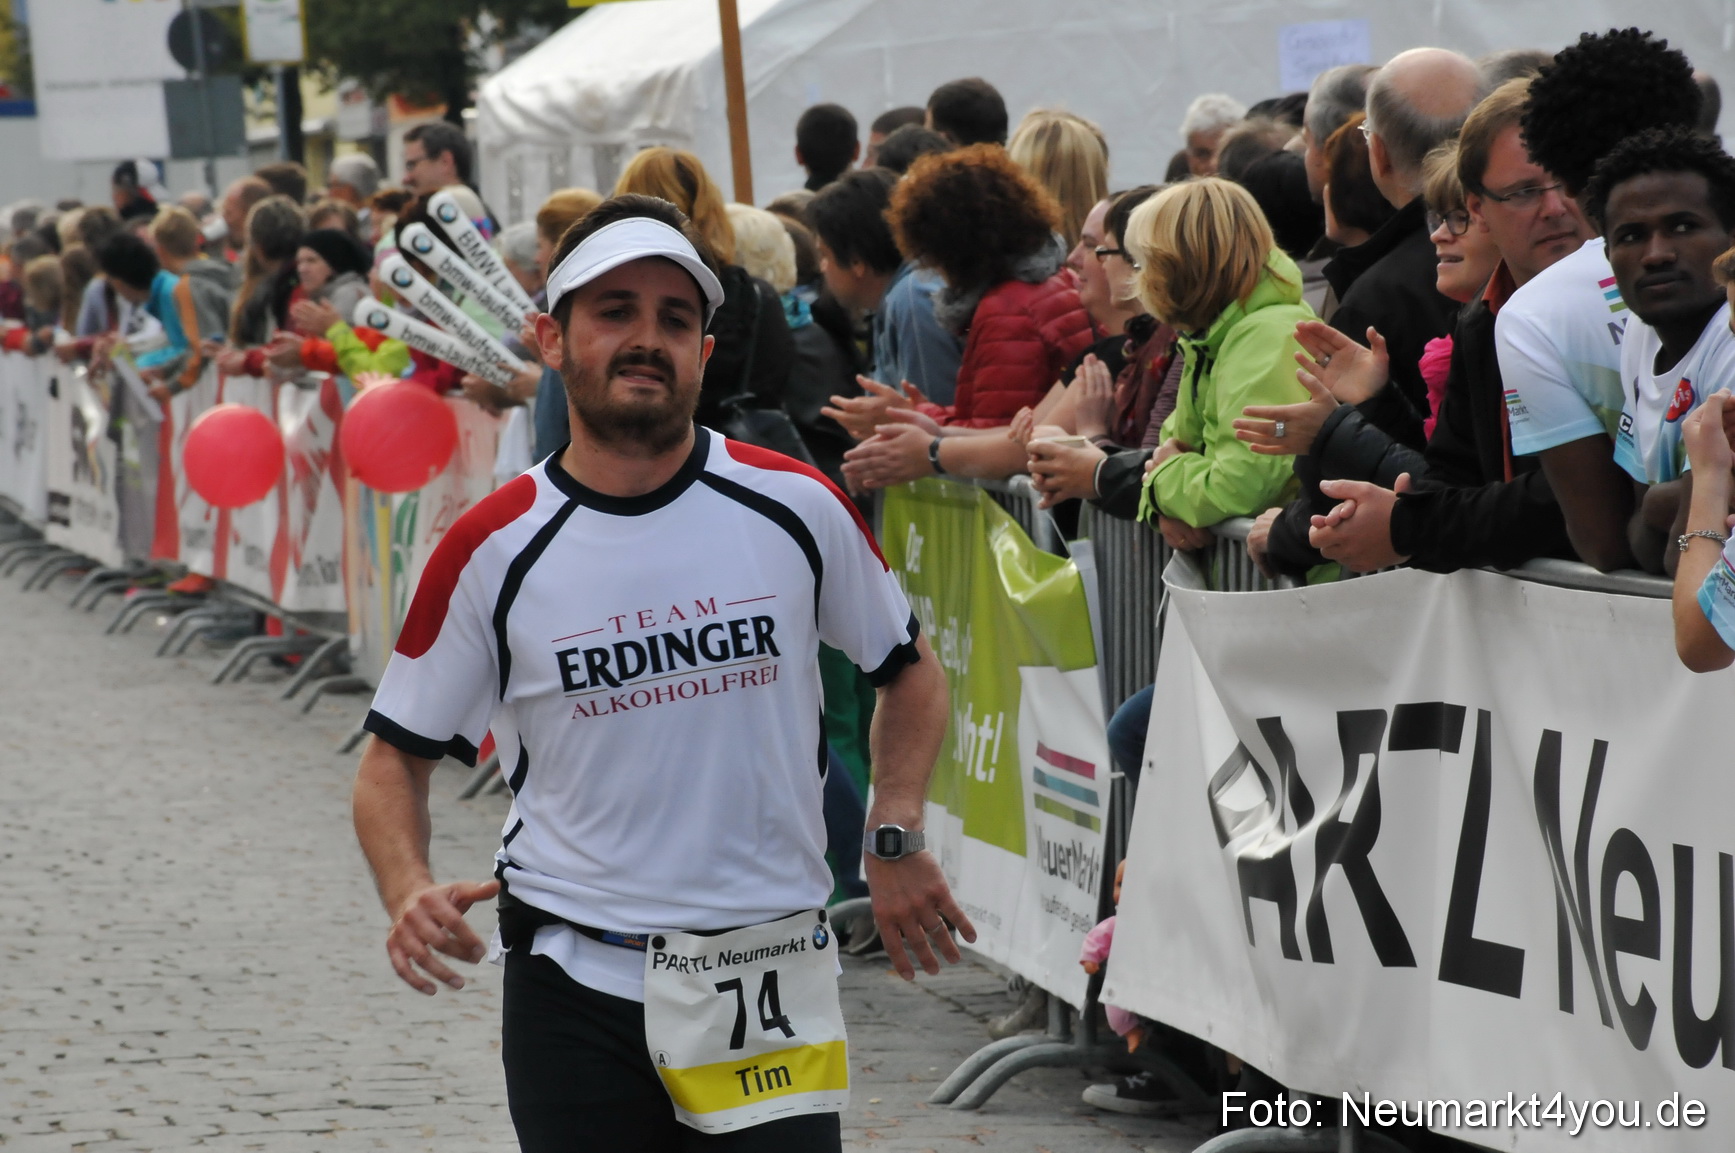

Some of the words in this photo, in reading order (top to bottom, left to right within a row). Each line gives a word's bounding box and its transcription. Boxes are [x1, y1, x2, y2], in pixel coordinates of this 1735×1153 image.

[458, 231, 499, 276] BMW
[439, 257, 521, 333] bmw-laufsp
[608, 597, 718, 633] TEAM
[555, 615, 781, 692] ERDINGER
[572, 665, 779, 719] ALKOHOLFREI
[1533, 728, 1735, 1071] Neu
[652, 951, 713, 974] PARTL
[717, 936, 807, 967] Neumarkt
[714, 969, 796, 1050] 74
[658, 1053, 667, 1066] A
[735, 1064, 792, 1097] Tim
